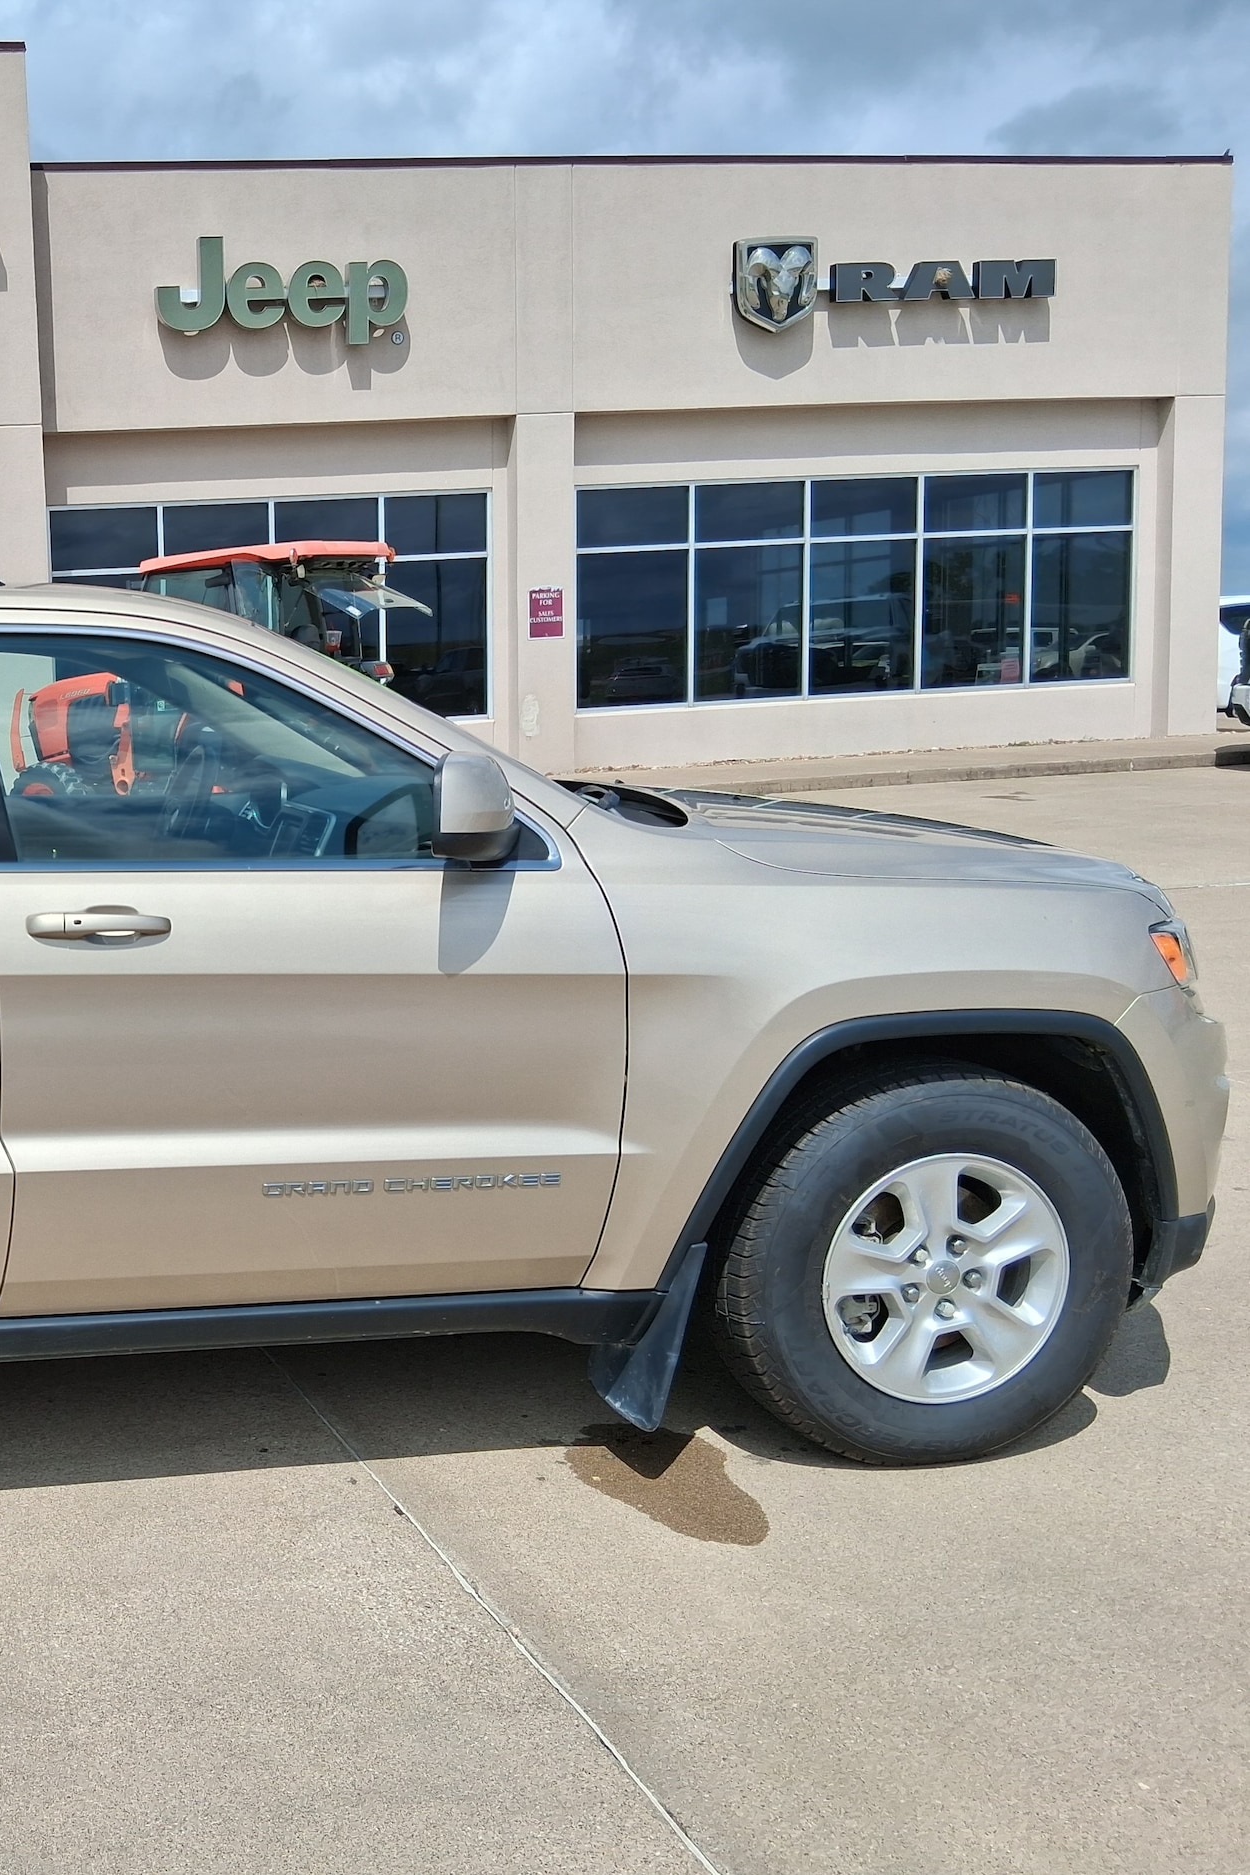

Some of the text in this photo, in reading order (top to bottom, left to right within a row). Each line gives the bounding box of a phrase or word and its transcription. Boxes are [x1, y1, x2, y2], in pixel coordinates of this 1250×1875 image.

[154, 236, 409, 345] Jeep
[830, 258, 1057, 303] RAM
[939, 1109, 1071, 1156] STRATUS
[262, 1171, 562, 1196] GRAND CHEROKEE
